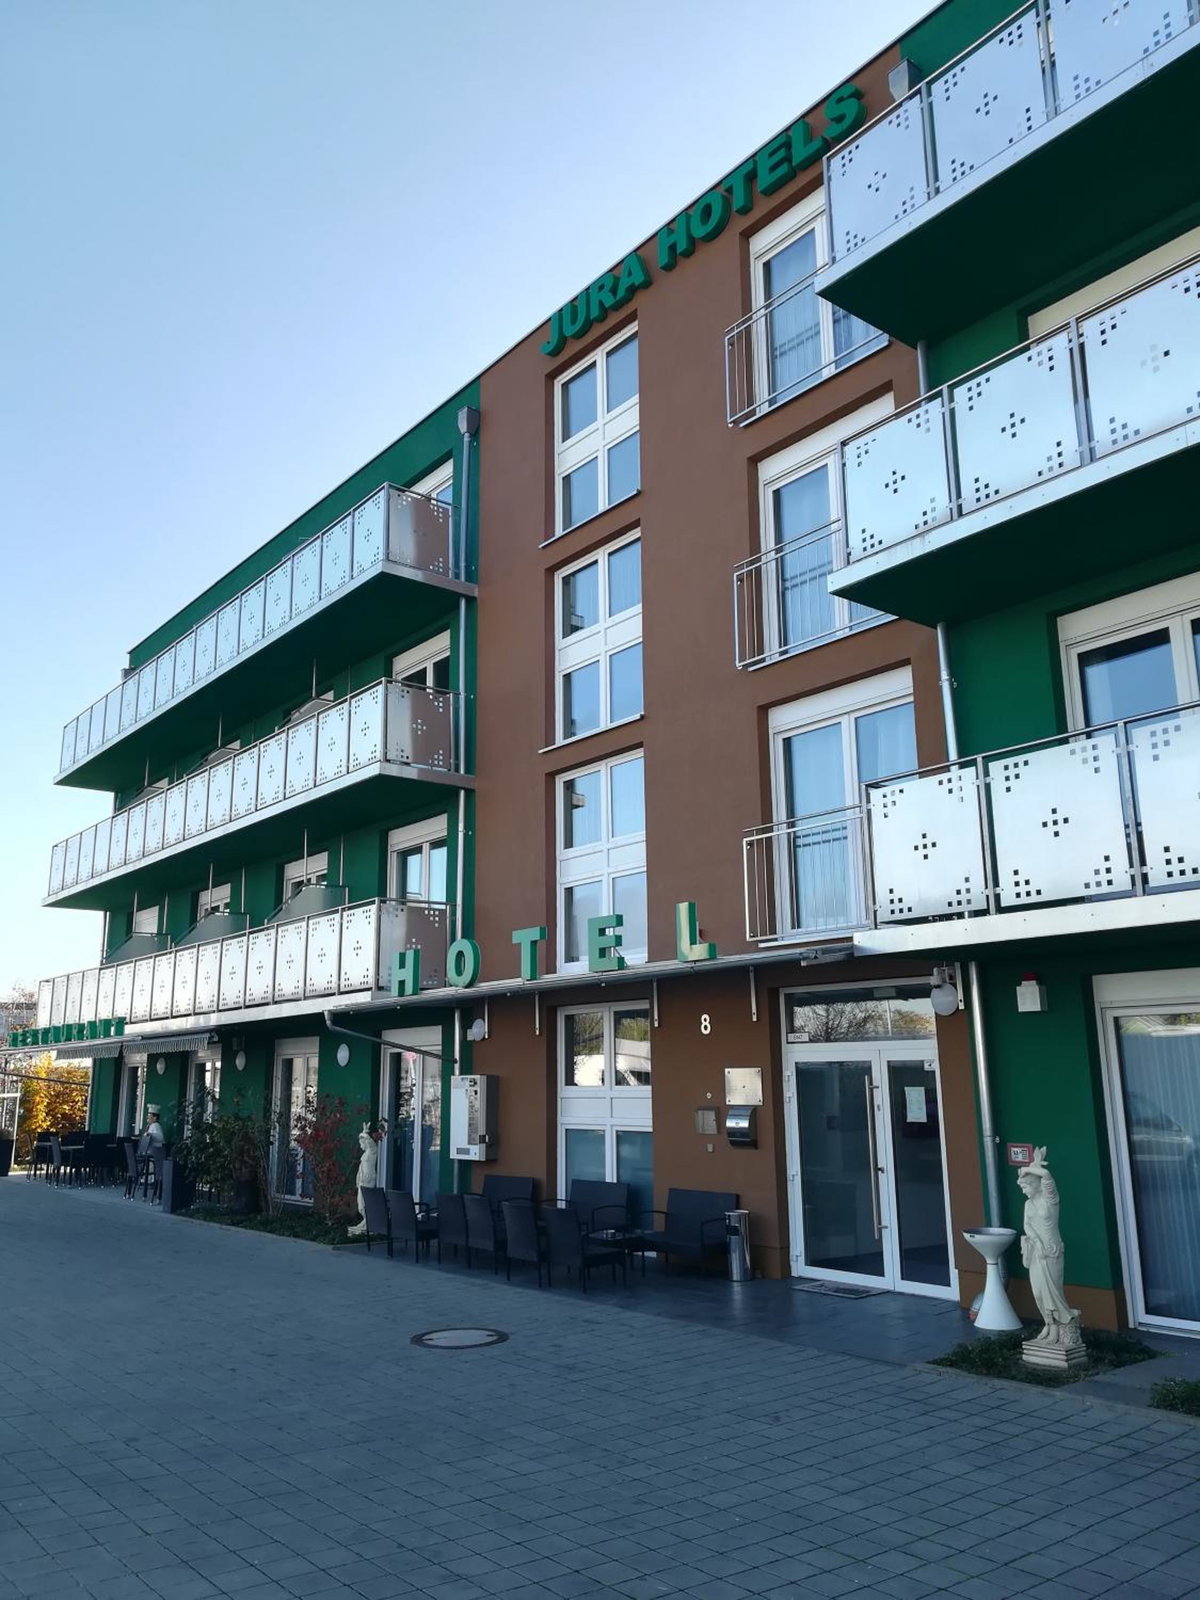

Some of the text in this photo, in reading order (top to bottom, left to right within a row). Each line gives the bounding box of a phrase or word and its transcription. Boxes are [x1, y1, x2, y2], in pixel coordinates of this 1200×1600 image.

[540, 82, 867, 357] JURA HOTELS
[391, 901, 717, 997] HOTEL
[700, 1013, 712, 1035] 8
